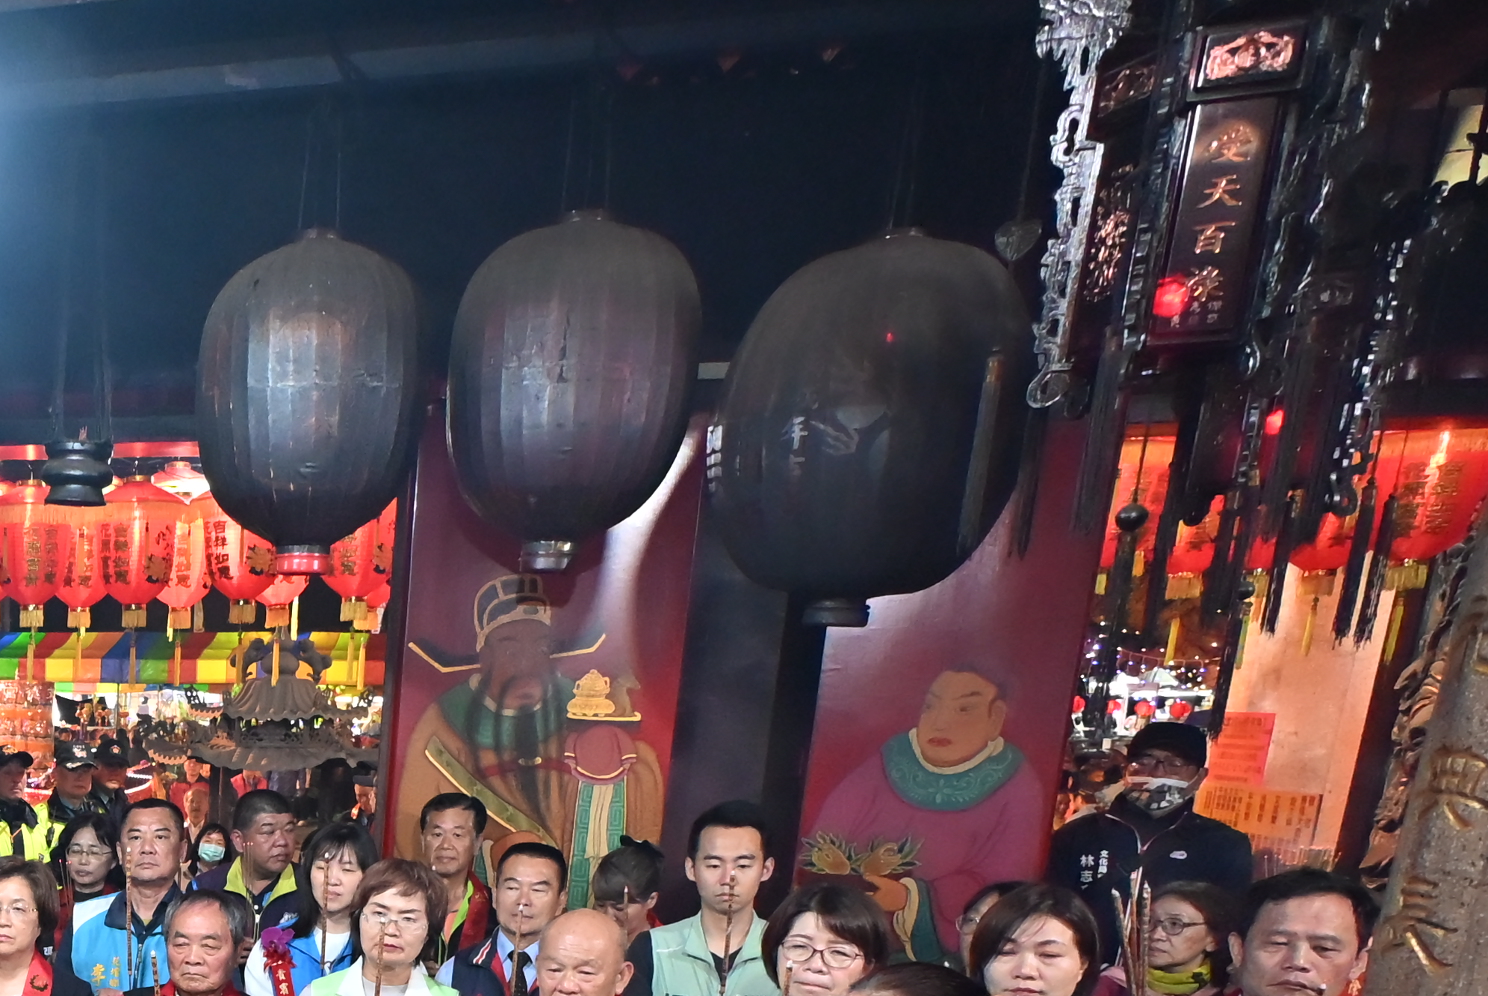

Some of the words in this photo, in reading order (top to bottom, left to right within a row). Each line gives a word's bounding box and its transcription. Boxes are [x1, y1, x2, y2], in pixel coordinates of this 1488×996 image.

[213, 519, 234, 580] 吉祥如意
[1079, 854, 1094, 889] 林志
[275, 967, 290, 996] 貴賓
